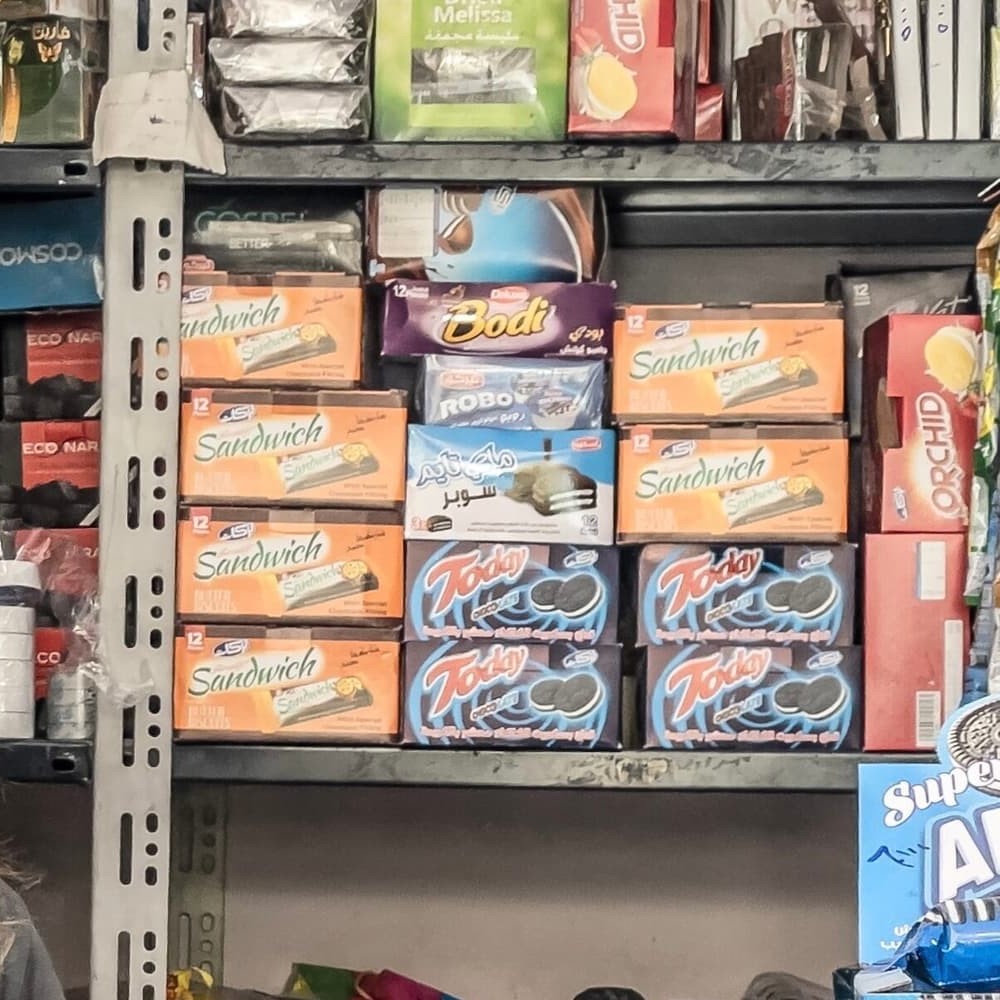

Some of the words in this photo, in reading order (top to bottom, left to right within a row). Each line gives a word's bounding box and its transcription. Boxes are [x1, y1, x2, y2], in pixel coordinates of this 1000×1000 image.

[434, 5, 513, 24] Melissa
[394, 285, 408, 298] 12
[181, 294, 281, 337] andwich
[442, 296, 550, 344] Bodi
[627, 315, 644, 329] 12
[28, 332, 61, 347] ECO
[629, 327, 761, 380] Sandwich
[193, 398, 209, 411] 12
[440, 391, 513, 419] ROBO
[194, 412, 323, 462] Sandwich
[633, 434, 650, 448] 12
[23, 441, 58, 455] ECO
[918, 393, 962, 516] ORCHID
[635, 446, 767, 499] Sandwich
[443, 486, 497, 510] سوبر
[193, 516, 209, 529] 12
[194, 529, 323, 580] Sandwich
[187, 632, 203, 645] 12
[37, 650, 61, 663] CO
[188, 646, 317, 697] Sandwich
